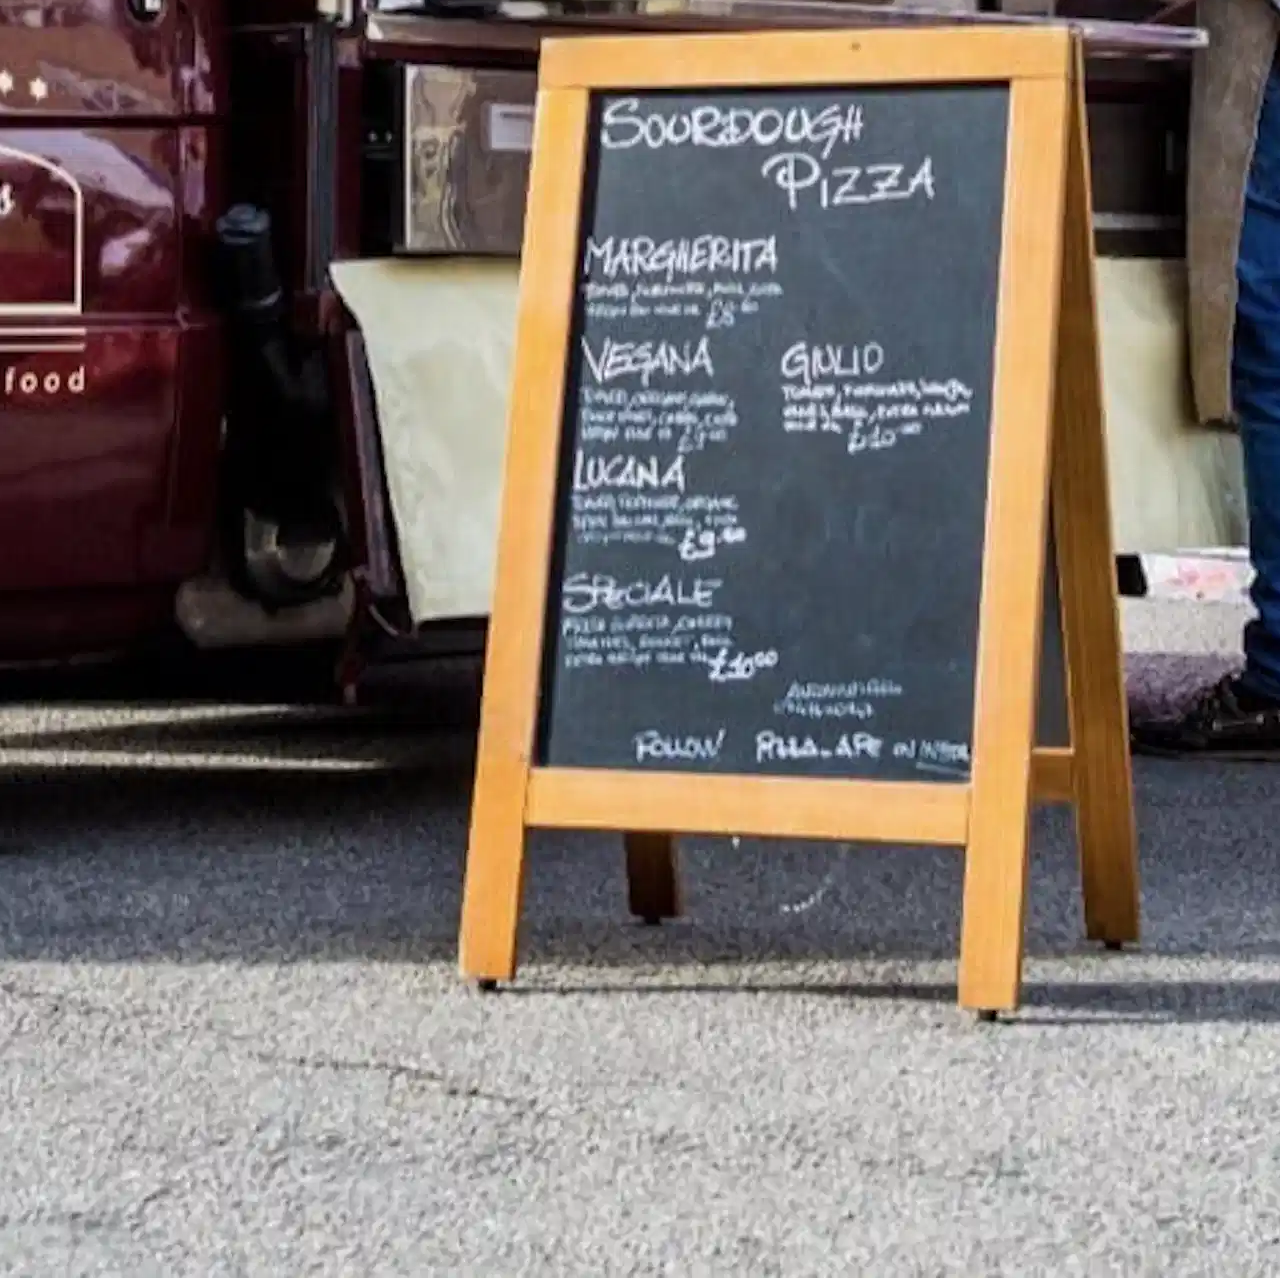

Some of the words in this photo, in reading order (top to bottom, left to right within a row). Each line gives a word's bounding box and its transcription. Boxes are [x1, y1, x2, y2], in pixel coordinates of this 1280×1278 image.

[600, 97, 864, 160] SOURDOUGH
[761, 151, 936, 211] PIZZA
[583, 234, 779, 283] MARGHERITA
[5, 365, 87, 396] food
[580, 333, 715, 388] VEGANA
[780, 339, 885, 387] GIULIO
[572, 446, 686, 494] LUCANA
